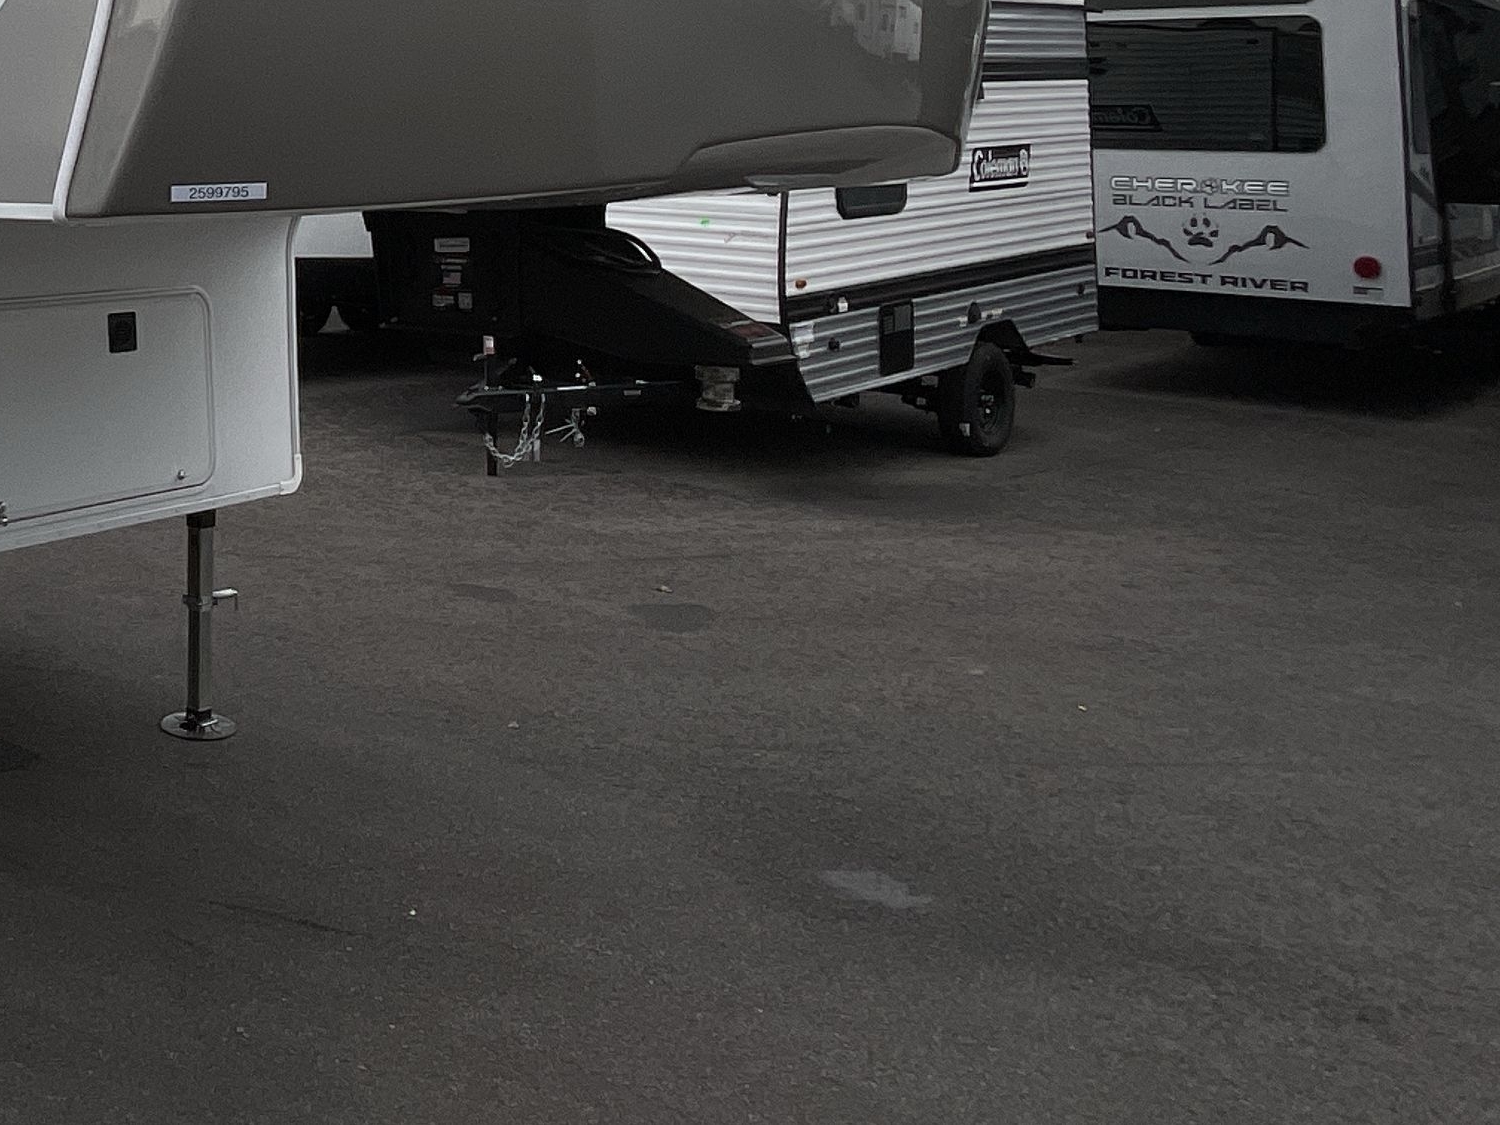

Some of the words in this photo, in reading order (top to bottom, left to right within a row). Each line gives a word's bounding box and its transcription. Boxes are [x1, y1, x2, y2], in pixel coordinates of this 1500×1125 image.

[972, 149, 1019, 182] Coleman
[188, 185, 250, 200] 2599795
[1112, 193, 1195, 208] BLACK
[1203, 197, 1288, 213] LABEL
[1104, 266, 1213, 286] FOREST
[1219, 275, 1310, 294] RIVER
